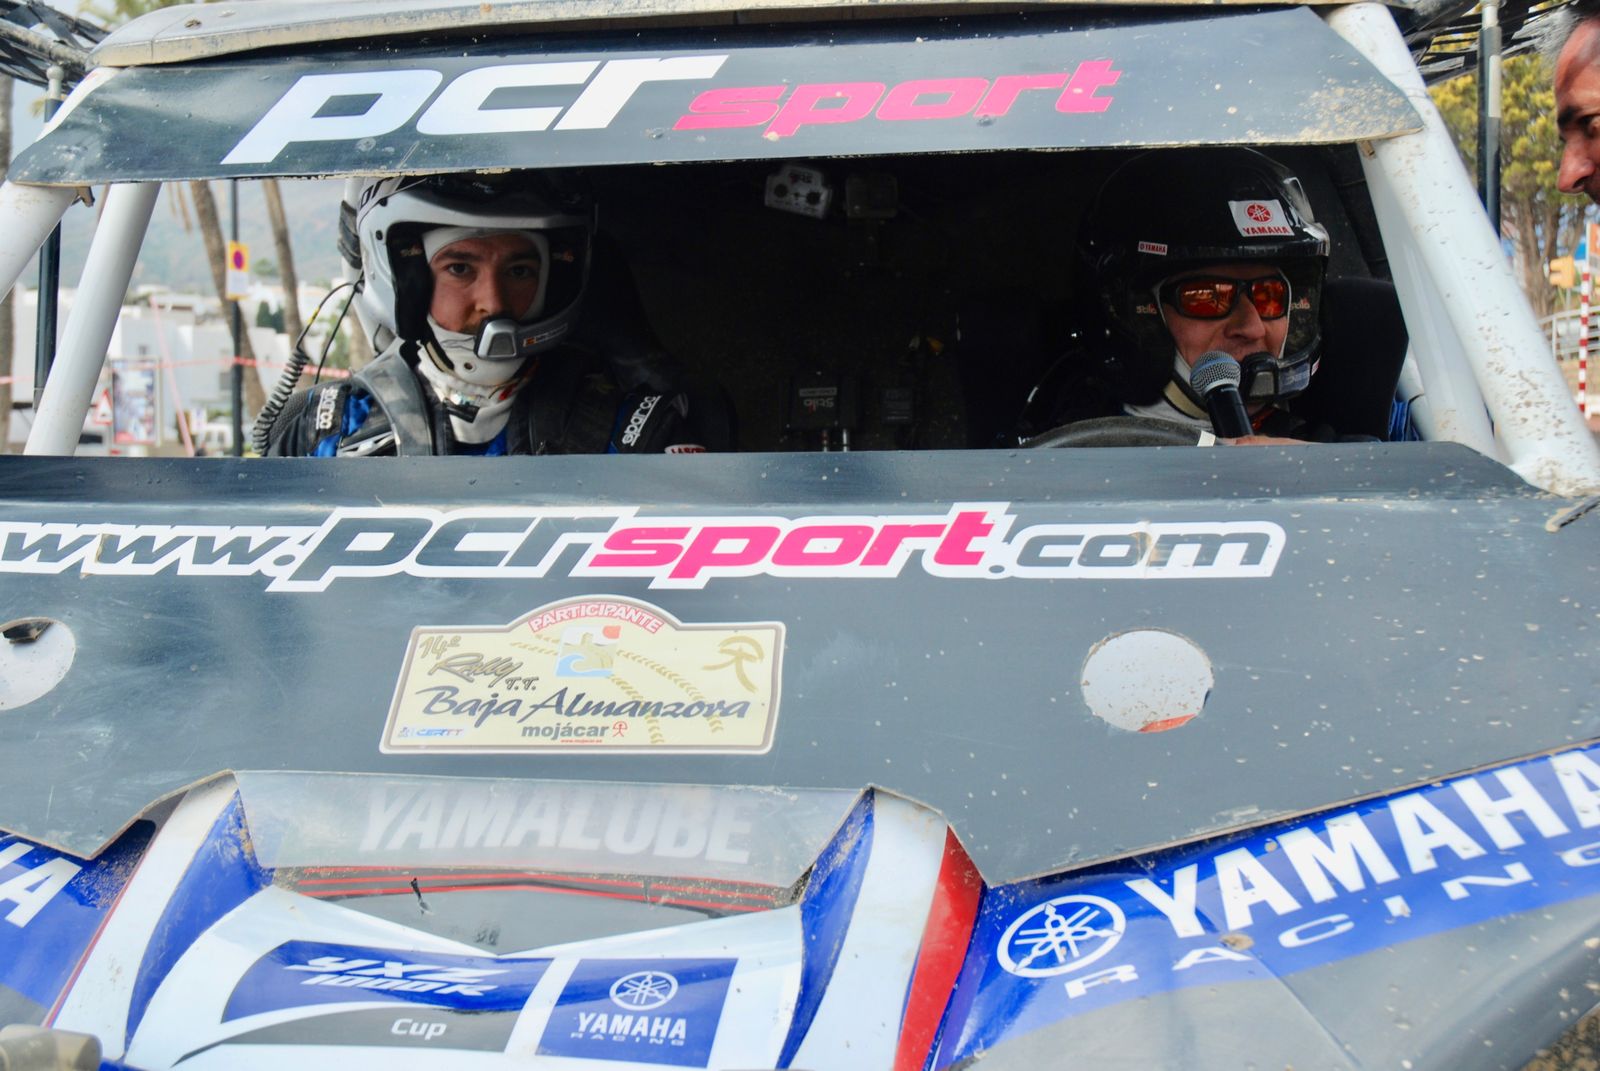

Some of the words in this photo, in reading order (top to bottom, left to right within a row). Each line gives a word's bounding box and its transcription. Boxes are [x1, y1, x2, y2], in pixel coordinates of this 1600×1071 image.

[1242, 225, 1290, 236] YAMAHA
[528, 602, 665, 634] PARTICIPANTE
[427, 652, 523, 688] Rally
[505, 676, 540, 691] T.T.
[415, 685, 523, 728] Baja
[517, 687, 751, 724] Almanzora
[521, 722, 608, 740] mojácar
[359, 785, 756, 865] YAMALUBE
[391, 1018, 448, 1040] Cup
[578, 1012, 687, 1039] YAMAHA
[570, 1032, 685, 1046] RACING
